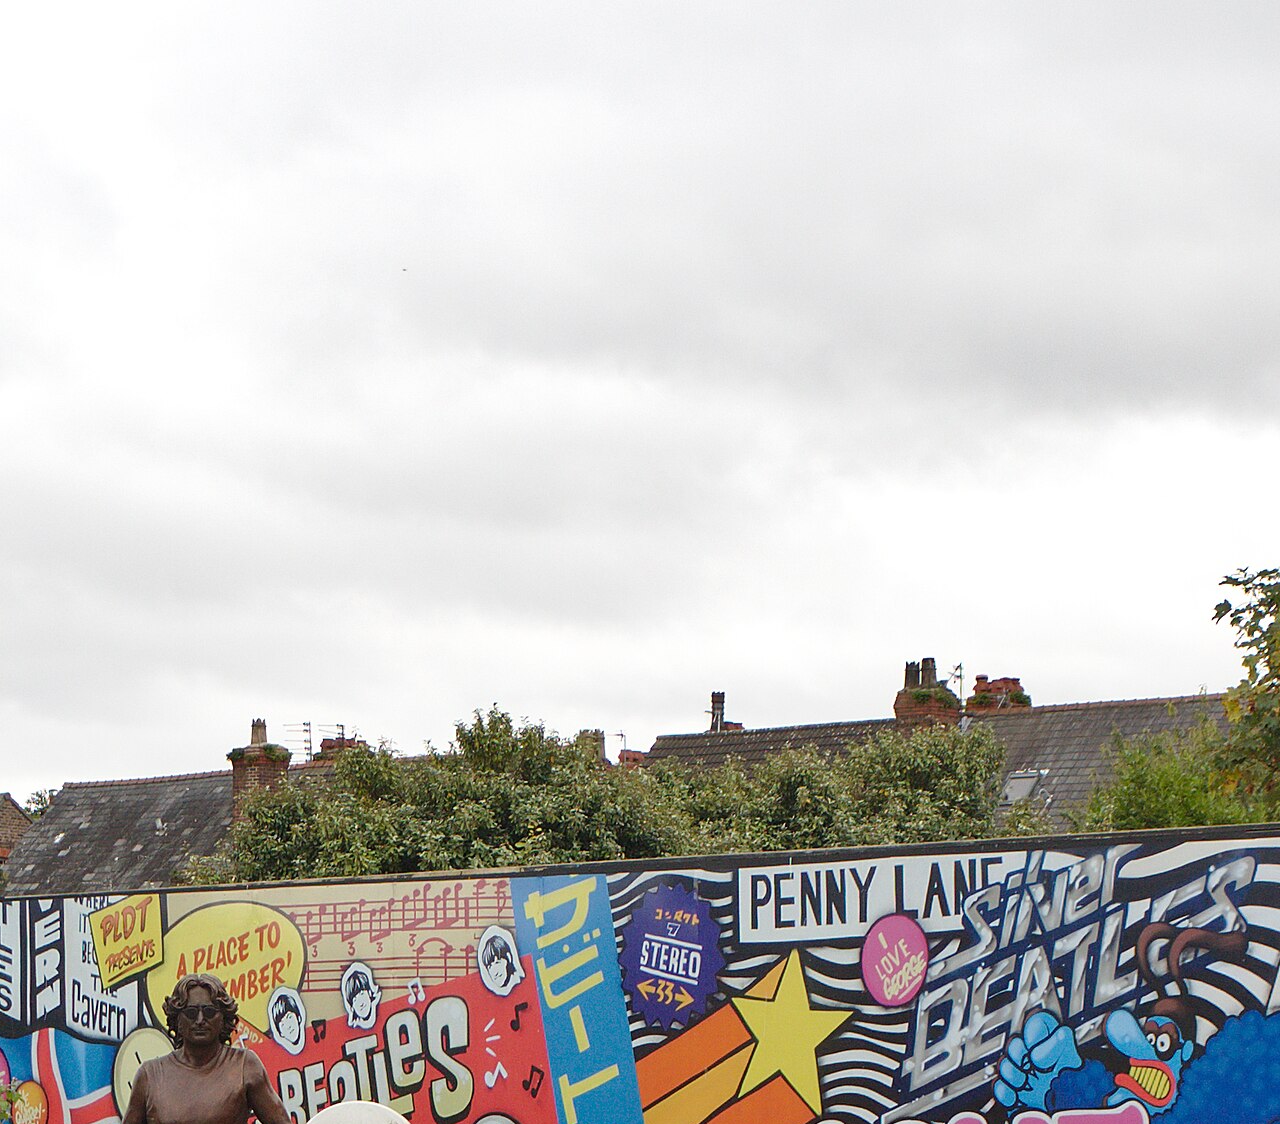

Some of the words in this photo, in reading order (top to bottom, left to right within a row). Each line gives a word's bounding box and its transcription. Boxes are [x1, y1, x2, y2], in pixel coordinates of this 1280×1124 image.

[100, 895, 153, 946] PLDT
[750, 864, 877, 931] PENNY
[105, 939, 156, 973] PRESENTS
[176, 952, 187, 980] A
[193, 931, 250, 974] PLACE
[255, 920, 281, 952] TO
[640, 940, 702, 979] STEREO
[875, 938, 911, 981] LOVE
[877, 931, 888, 950] I
[656, 979, 675, 1005] 33
[883, 950, 927, 1001] GEORGE
[71, 978, 127, 1041] Cavern
